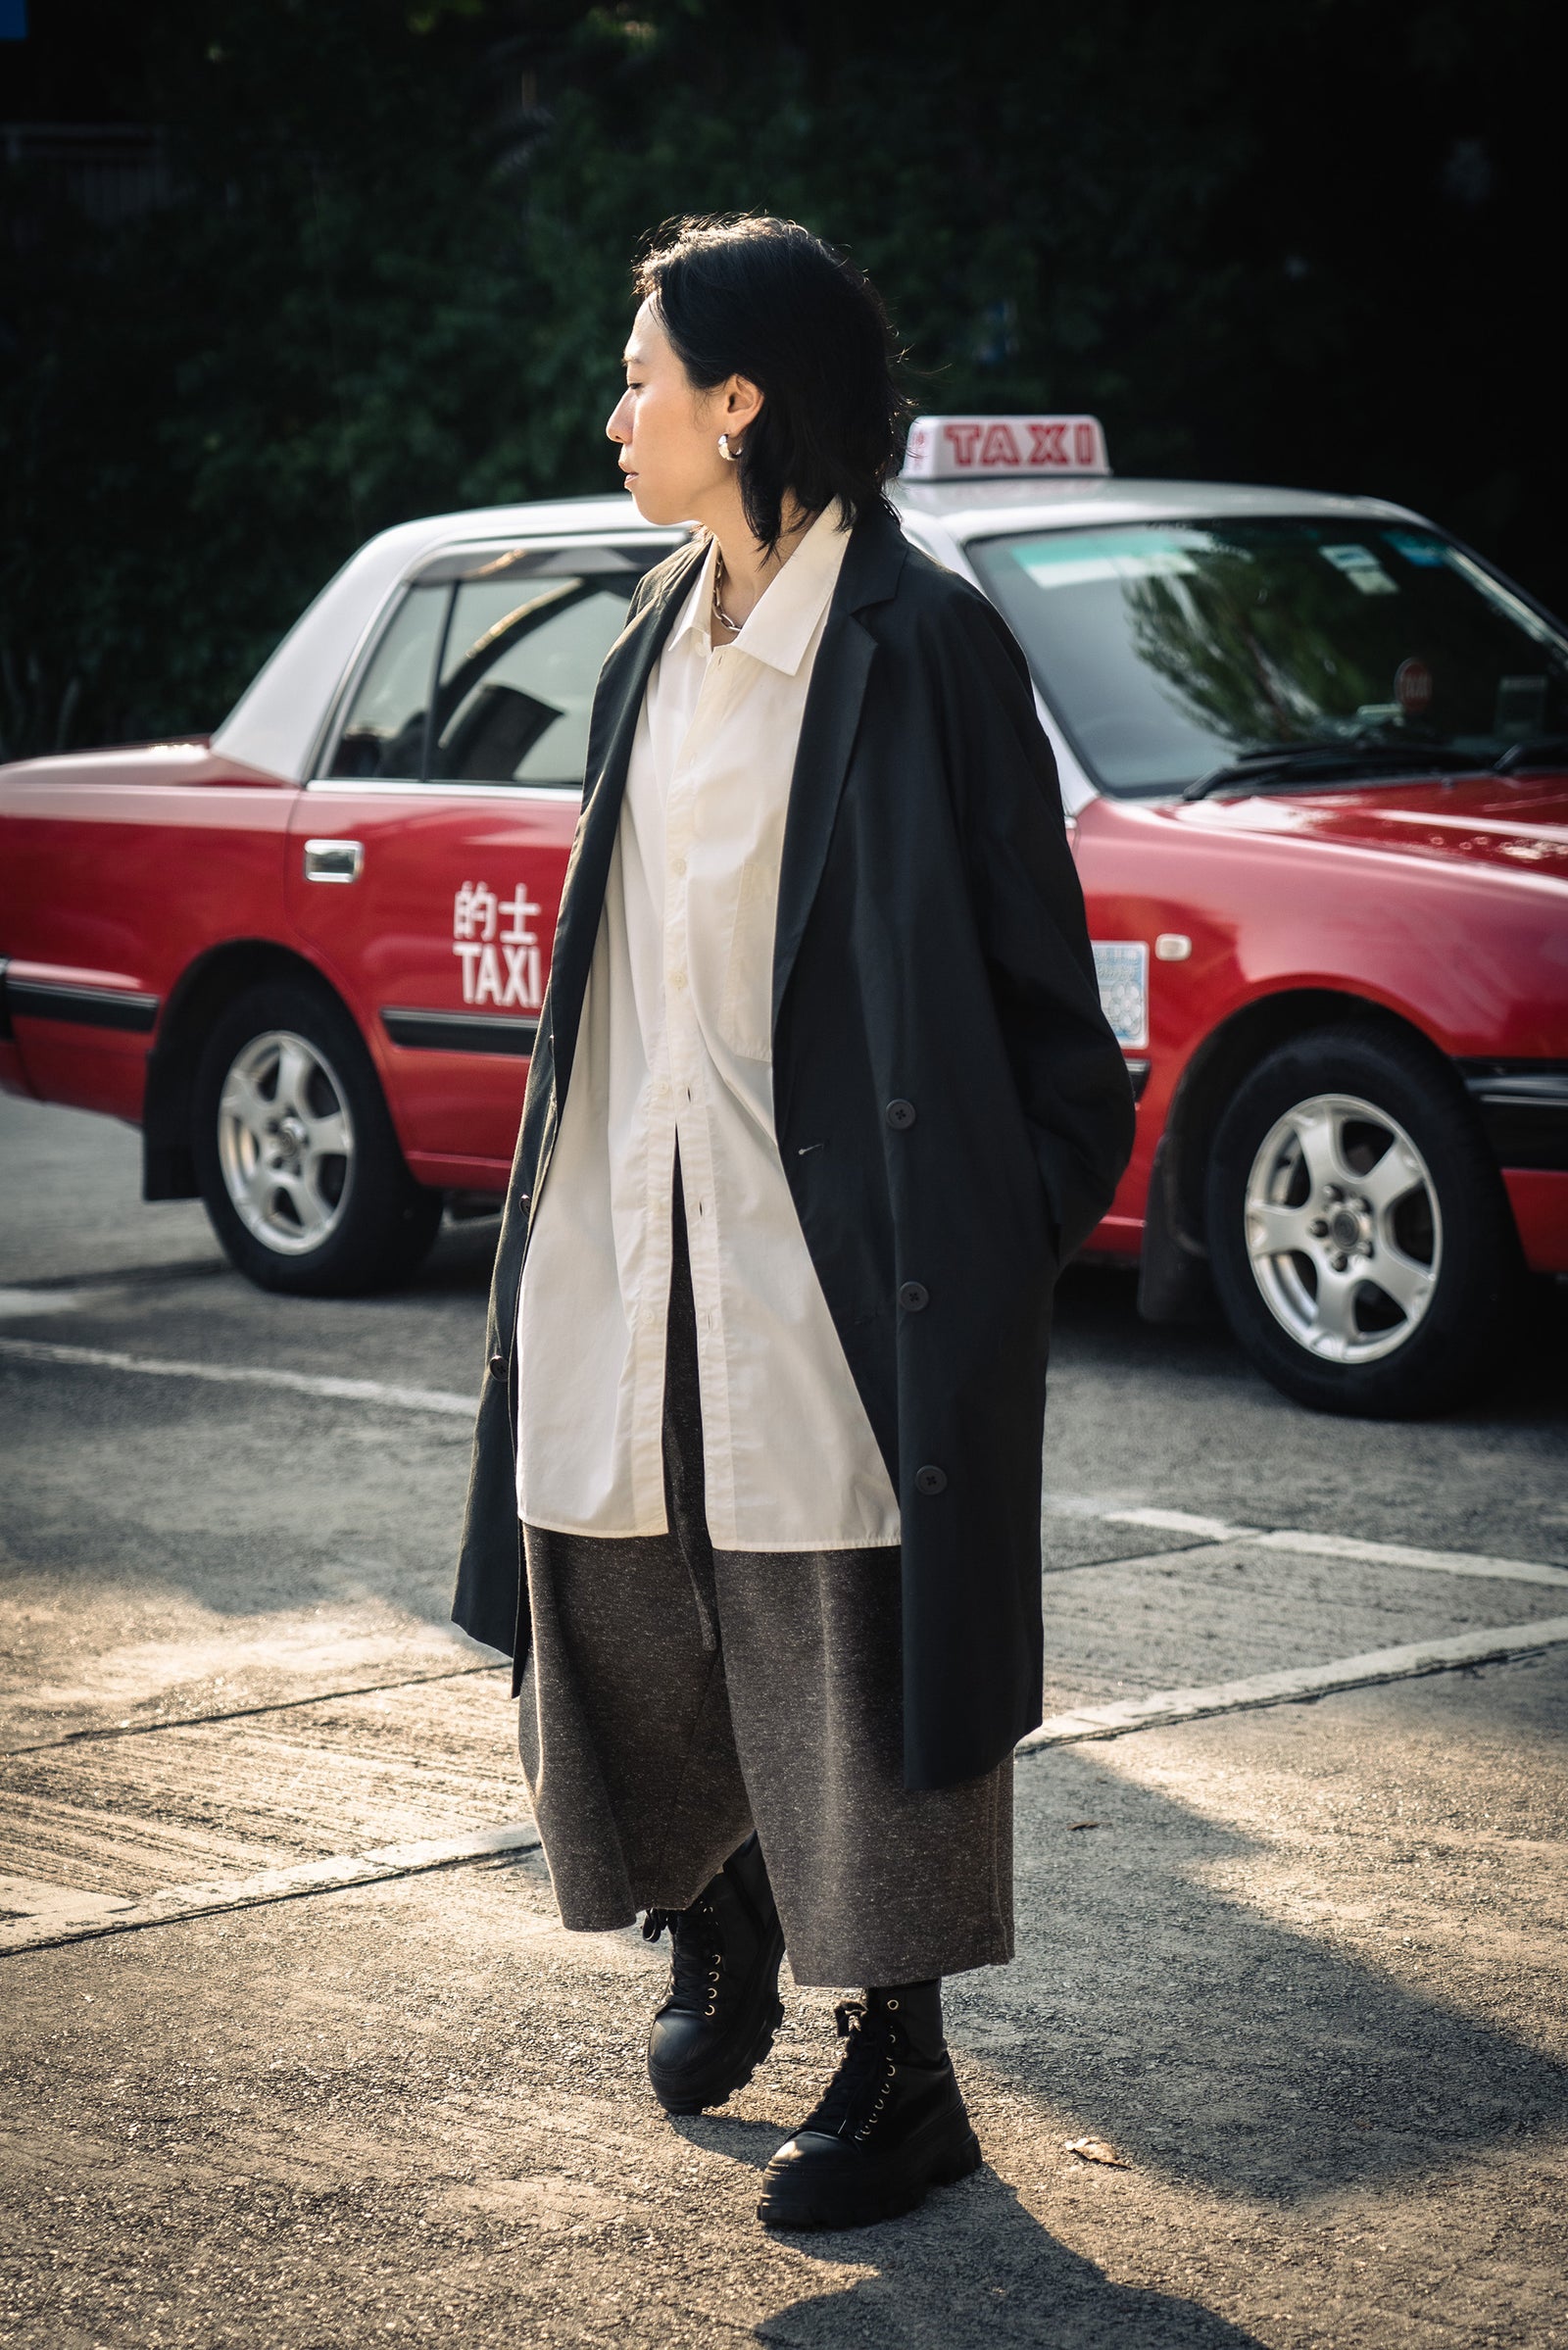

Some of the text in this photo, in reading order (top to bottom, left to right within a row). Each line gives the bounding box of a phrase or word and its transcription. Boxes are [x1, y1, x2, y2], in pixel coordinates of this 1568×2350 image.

[944, 423, 1094, 466] TAXI
[453, 880, 542, 945] 的士
[452, 941, 542, 1008] TAXI
